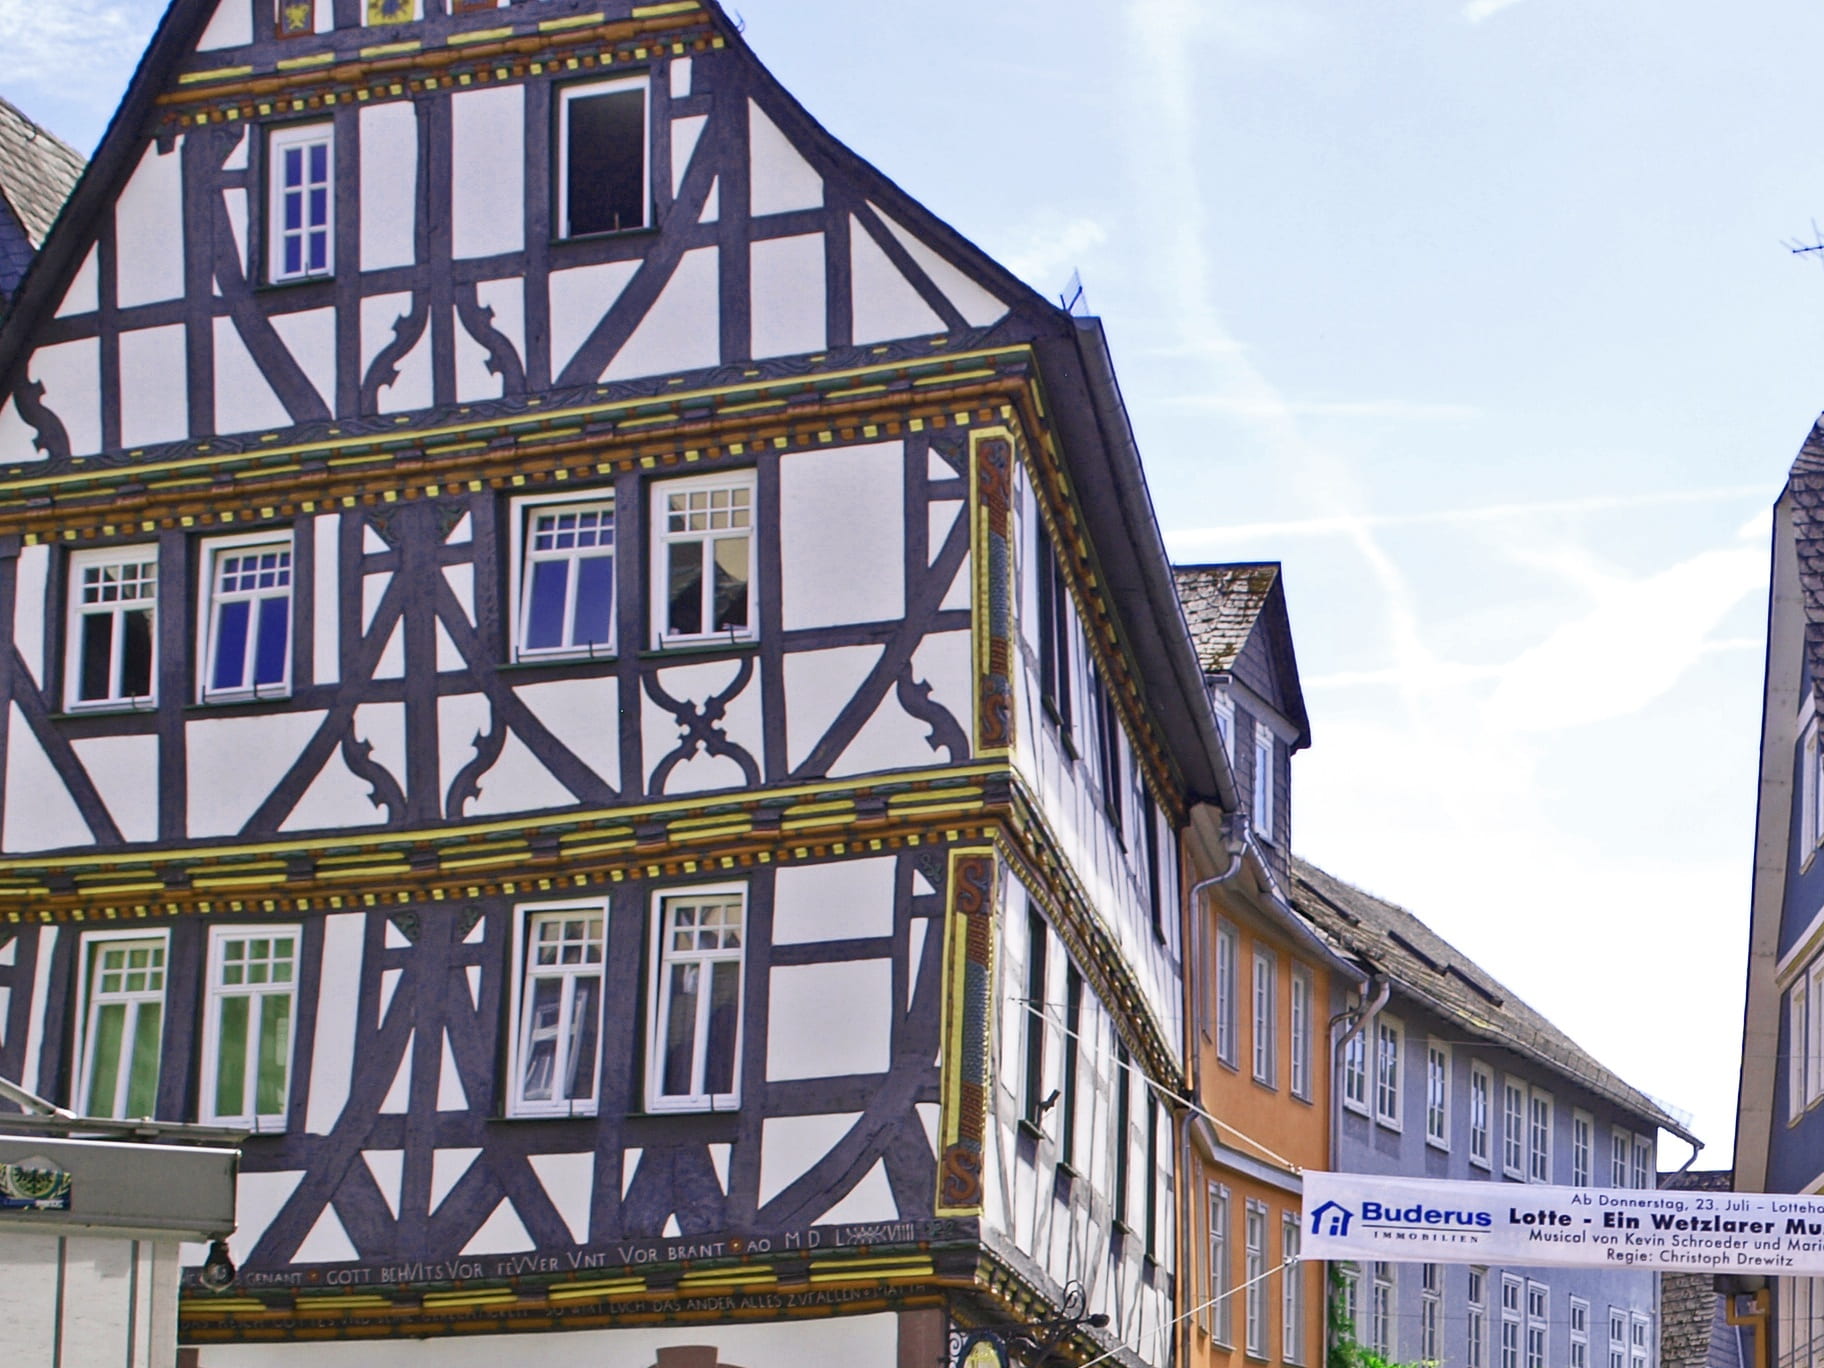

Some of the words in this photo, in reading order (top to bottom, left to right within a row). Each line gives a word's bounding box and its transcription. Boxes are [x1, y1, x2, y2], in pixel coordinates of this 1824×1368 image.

[1571, 1193, 1592, 1206] Ab
[1599, 1195, 1689, 1212] Donnerstag,
[1696, 1198, 1719, 1211] 23.
[1725, 1199, 1750, 1211] Juli
[1361, 1201, 1492, 1227] Buderus
[1509, 1208, 1572, 1226] Lotte
[1603, 1211, 1640, 1229] Ein
[1651, 1213, 1775, 1234] Wetzlarer
[1374, 1231, 1479, 1243] IMMOBILIEN
[1529, 1229, 1586, 1243] Musical
[1592, 1235, 1618, 1245] von
[1625, 1233, 1665, 1246] Kevin
[1672, 1234, 1748, 1249] Schroeder
[1754, 1237, 1781, 1250] und
[326, 1268, 372, 1285] GOTT
[567, 1251, 607, 1270] VNT
[618, 1245, 659, 1265] VOR
[667, 1242, 725, 1261] BRANT
[1607, 1248, 1653, 1265] Regie:
[1659, 1250, 1730, 1267] Christoph
[1737, 1253, 1794, 1267] Drewitz
[740, 1293, 783, 1309] ALLES
